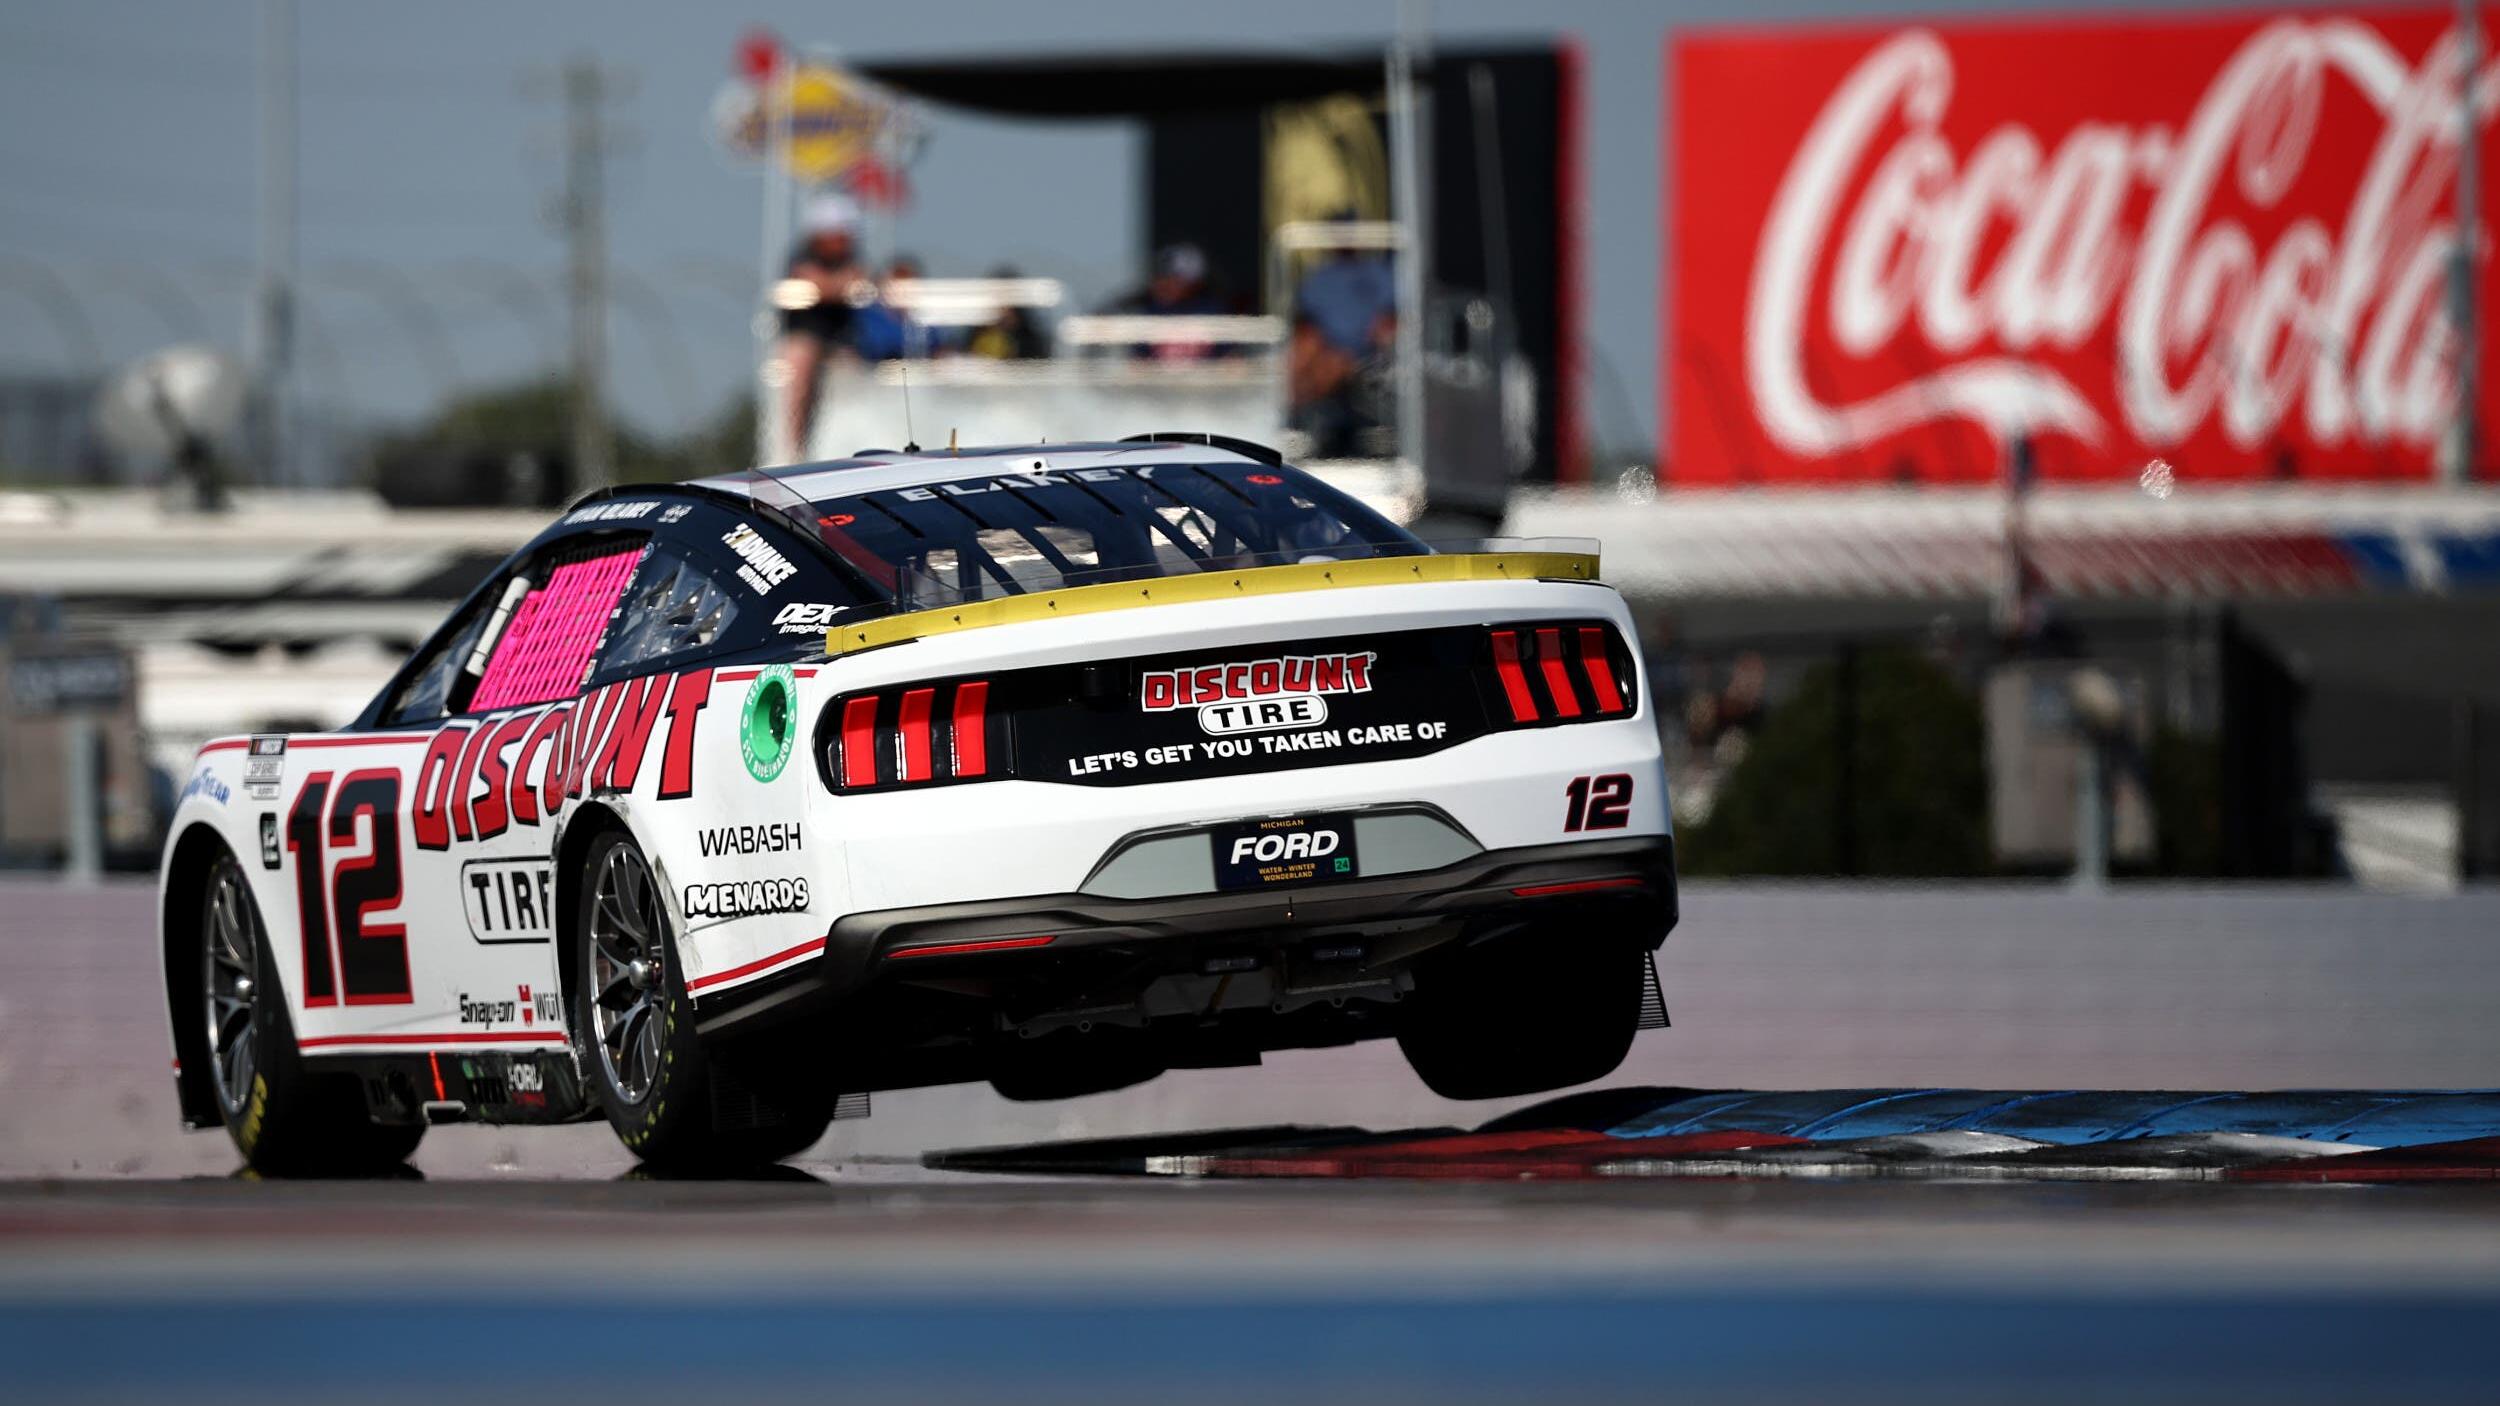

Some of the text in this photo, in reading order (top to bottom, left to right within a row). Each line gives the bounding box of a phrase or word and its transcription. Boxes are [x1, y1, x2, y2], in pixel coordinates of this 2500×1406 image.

[732, 533, 798, 587] ADVANCE
[771, 603, 850, 625] DEX
[1142, 653, 1370, 712] DISCOUNT
[1212, 700, 1313, 729] TIRE
[413, 668, 713, 852] DISCOUNT
[1069, 721, 1447, 776] LET'S GET YOU TAKEN CARE OF
[1563, 772, 1634, 833] 12
[699, 822, 802, 857] WABASH
[1260, 818, 1304, 830] MICHIGAN
[1230, 830, 1340, 865] FORD
[1336, 858, 1349, 871] 24
[1258, 865, 1283, 875] WATER
[1288, 862, 1316, 873] WINTER
[1263, 870, 1313, 882] WONDERLAND
[286, 766, 414, 1009] 12
[685, 877, 810, 919] MENARDS
[459, 992, 515, 1031] Snap-on
